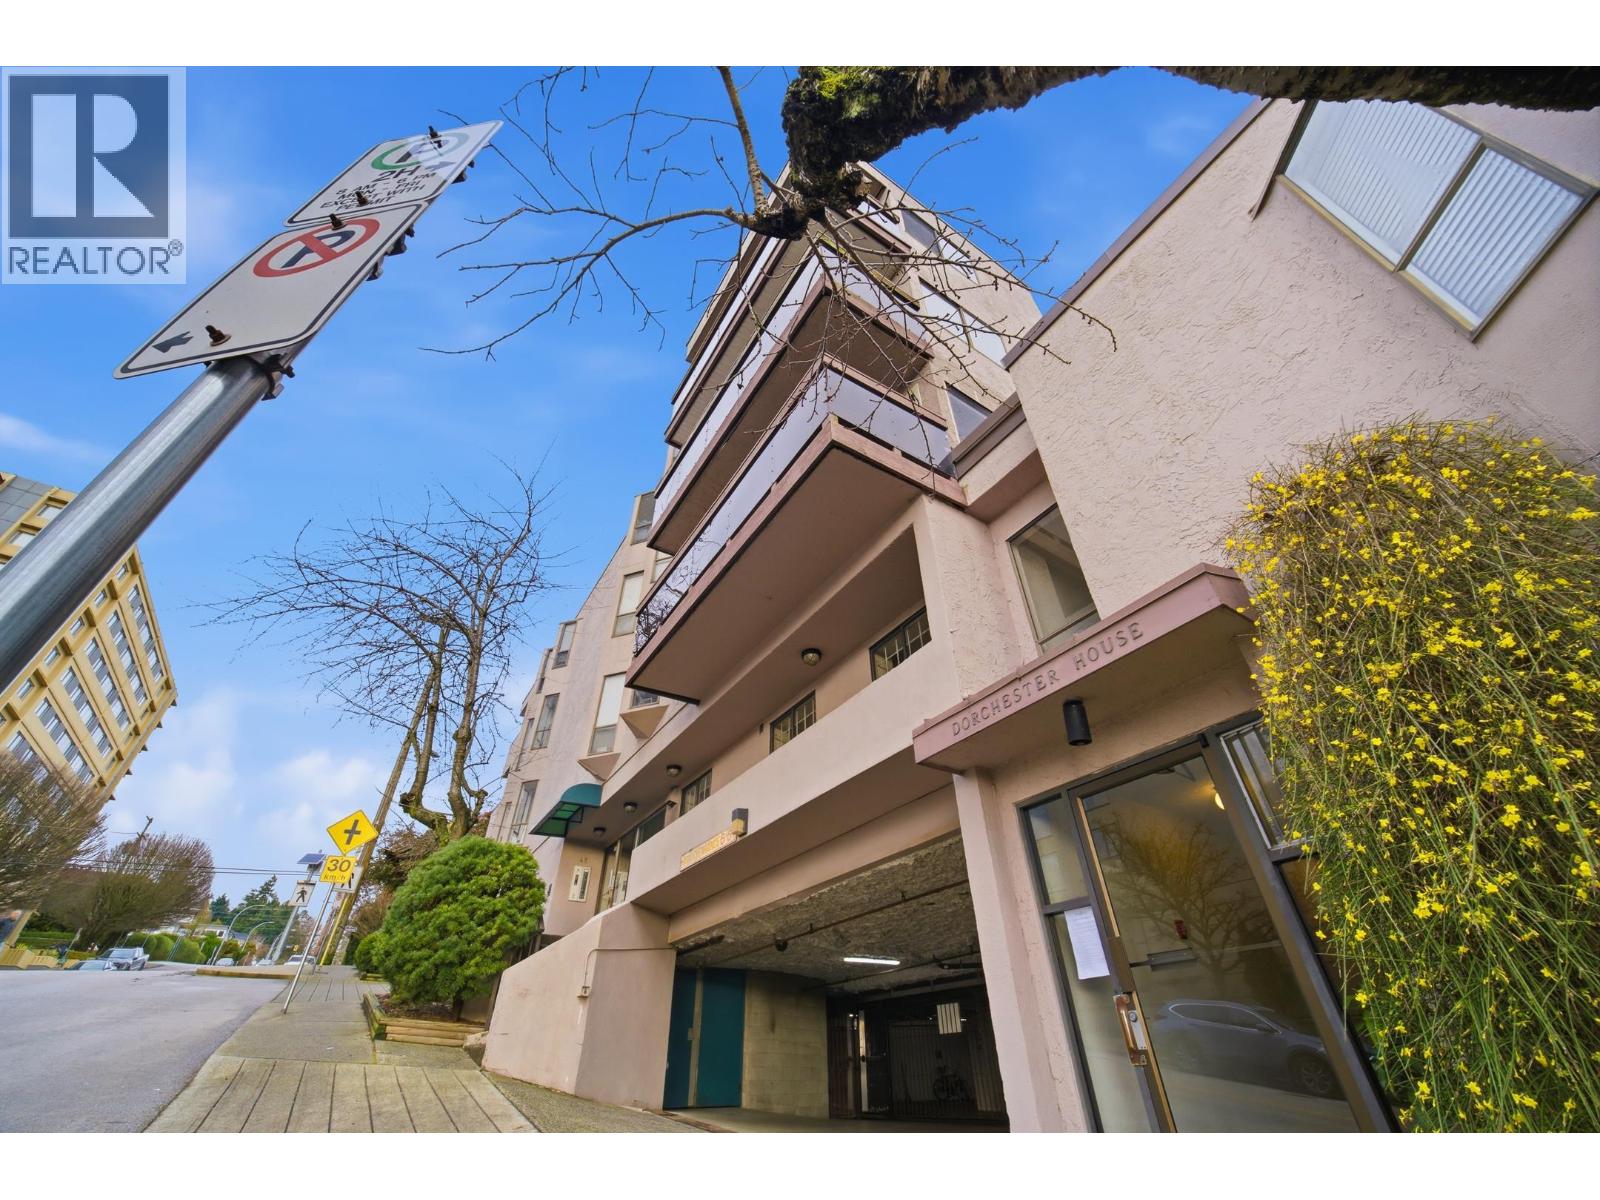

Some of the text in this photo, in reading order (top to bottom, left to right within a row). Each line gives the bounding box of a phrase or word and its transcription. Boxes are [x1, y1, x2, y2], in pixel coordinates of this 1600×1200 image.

[353, 182, 378, 191] AM
[387, 184, 426, 196] WITH
[335, 195, 396, 211] PEMIT
[952, 621, 1144, 737] DORCHESTER HOUSE
[327, 859, 351, 872] 30
[323, 873, 346, 881] kmh
